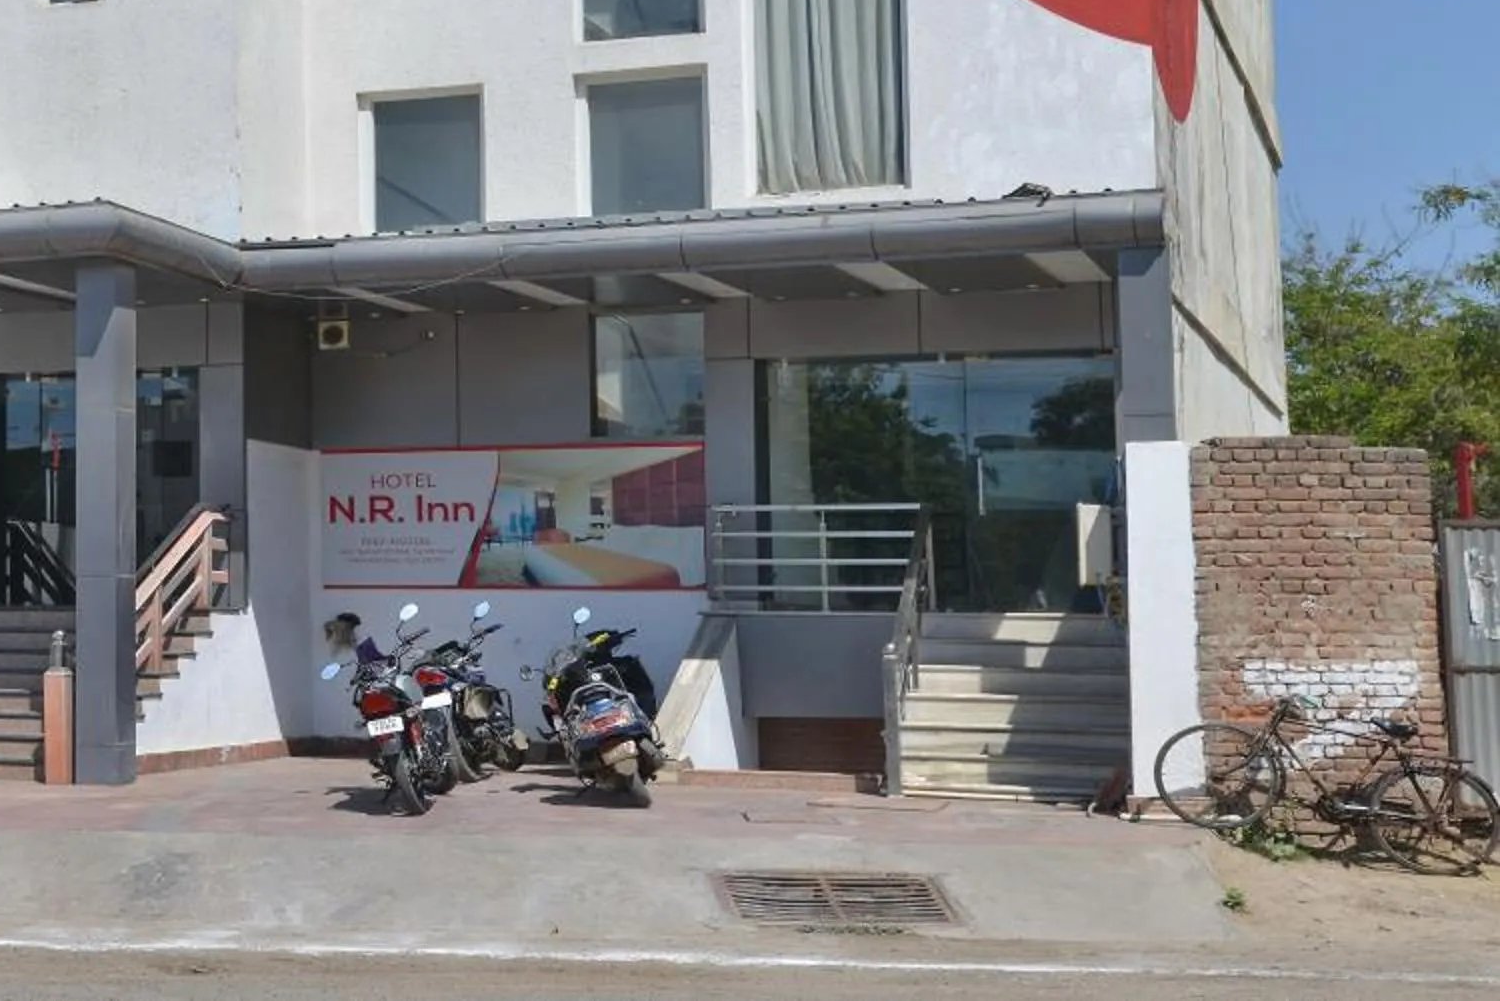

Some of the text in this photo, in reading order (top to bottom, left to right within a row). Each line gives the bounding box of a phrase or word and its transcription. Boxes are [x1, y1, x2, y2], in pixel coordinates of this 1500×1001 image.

[371, 472, 436, 489] HOTEL
[329, 495, 475, 524] N.R. Inn
